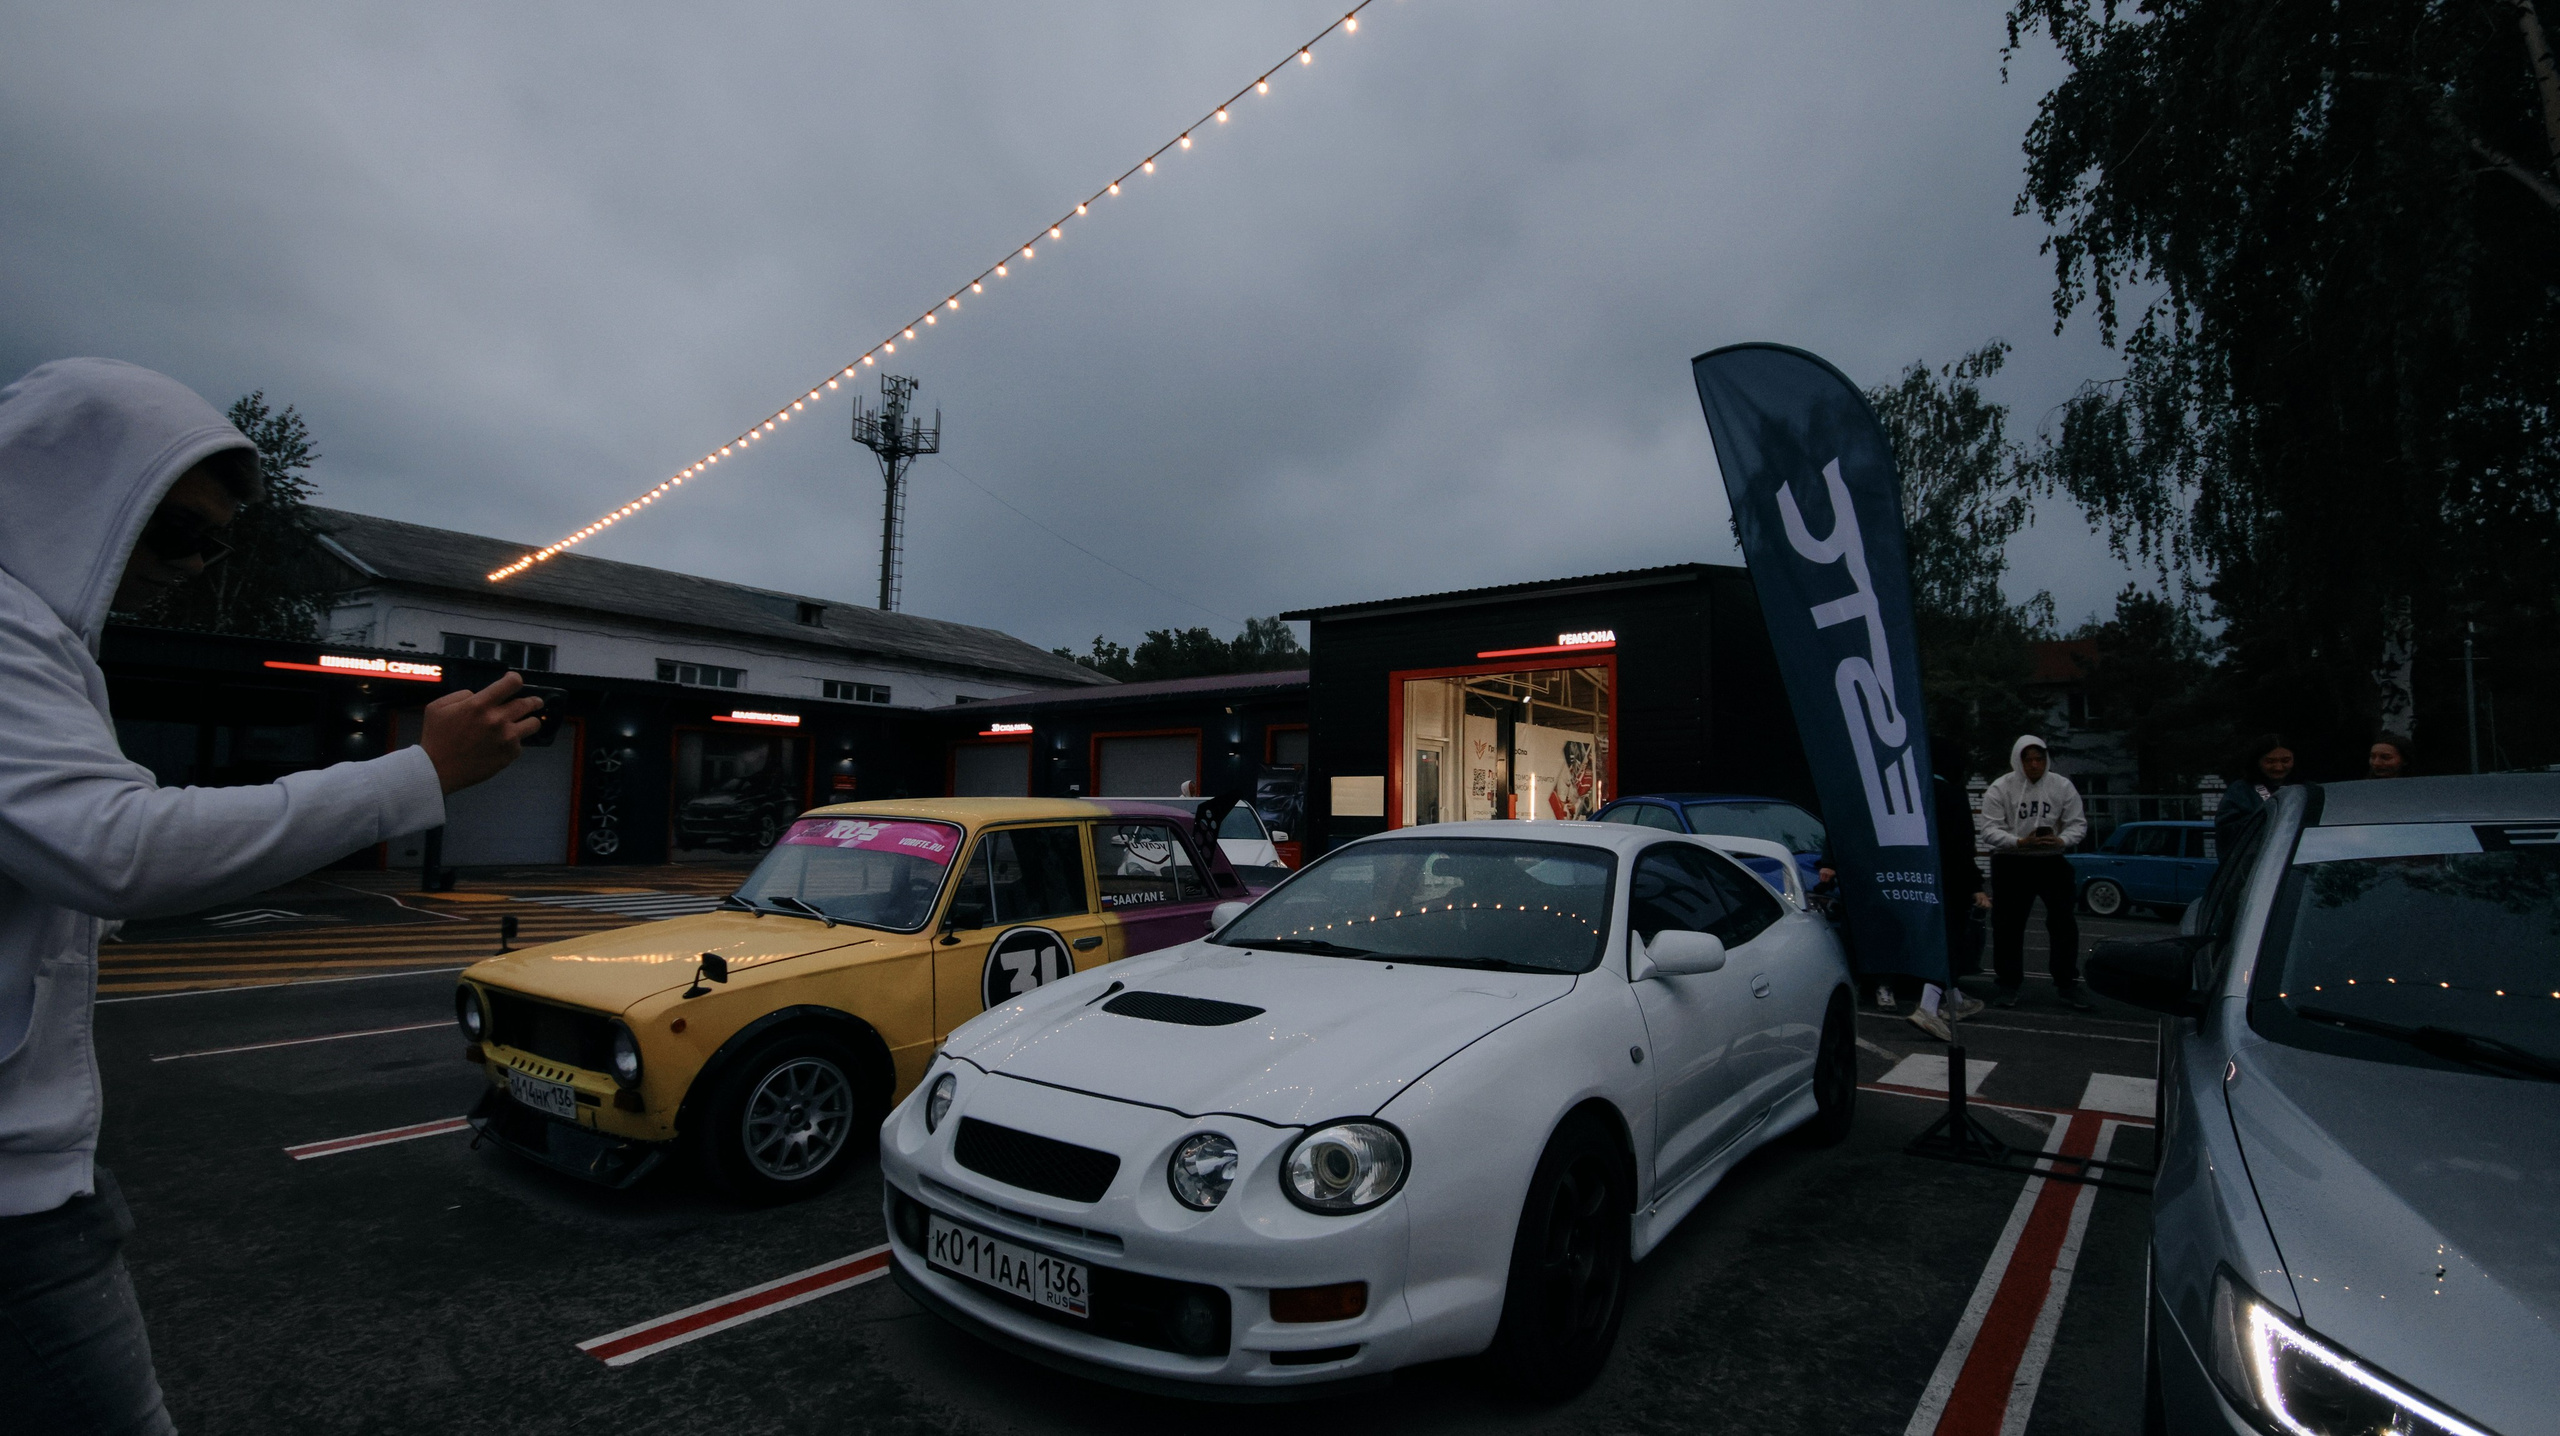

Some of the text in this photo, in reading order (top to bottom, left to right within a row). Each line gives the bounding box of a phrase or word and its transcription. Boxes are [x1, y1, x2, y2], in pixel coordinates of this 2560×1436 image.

[1559, 630, 1616, 645] РЕМЗОНА
[320, 655, 443, 677] ШИННЫЙ СЕРВИС
[2019, 801, 2051, 819] GAP
[824, 818, 893, 843] RDS
[1112, 891, 1157, 906] SAAKYAN
[1158, 890, 1168, 902] E.
[1000, 946, 1058, 994] 31
[551, 1086, 574, 1108] 136
[935, 1228, 1081, 1298] К011АА 136
[1046, 1291, 1069, 1308] RUS
